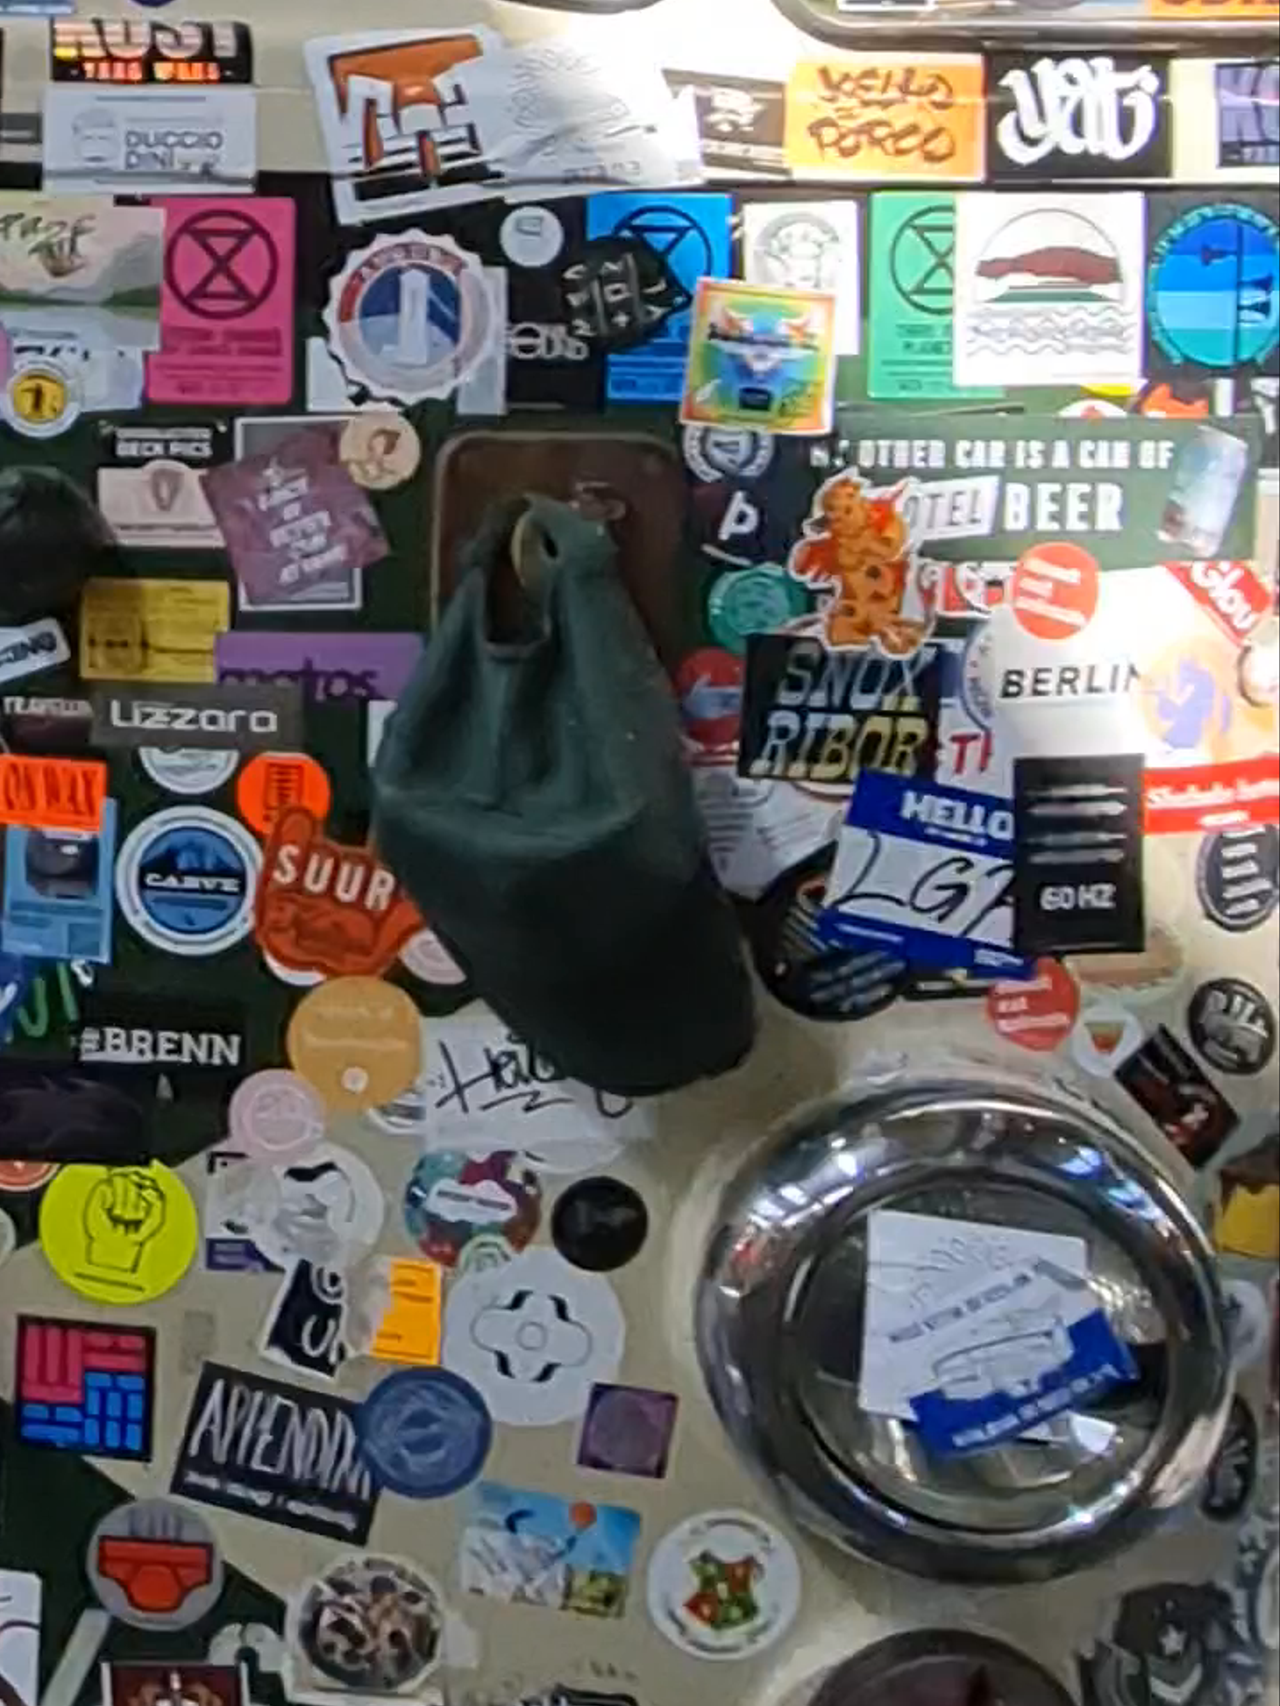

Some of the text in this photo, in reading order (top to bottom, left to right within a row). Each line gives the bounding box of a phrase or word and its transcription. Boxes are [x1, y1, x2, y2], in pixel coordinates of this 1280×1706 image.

[125, 130, 223, 151] DUCCIO
[859, 440, 946, 469] OTHER
[954, 441, 1006, 469] CAR
[1014, 440, 1044, 469] IS
[1051, 441, 1070, 469] A
[1077, 440, 1130, 469] CAN
[1138, 441, 1175, 469] OF
[903, 489, 986, 534] OTEL
[1004, 484, 1124, 531] BEER
[3, 759, 38, 814] ON
[43, 762, 103, 819] WAX
[899, 790, 1015, 837] HELLO
[273, 843, 396, 910] SUUR
